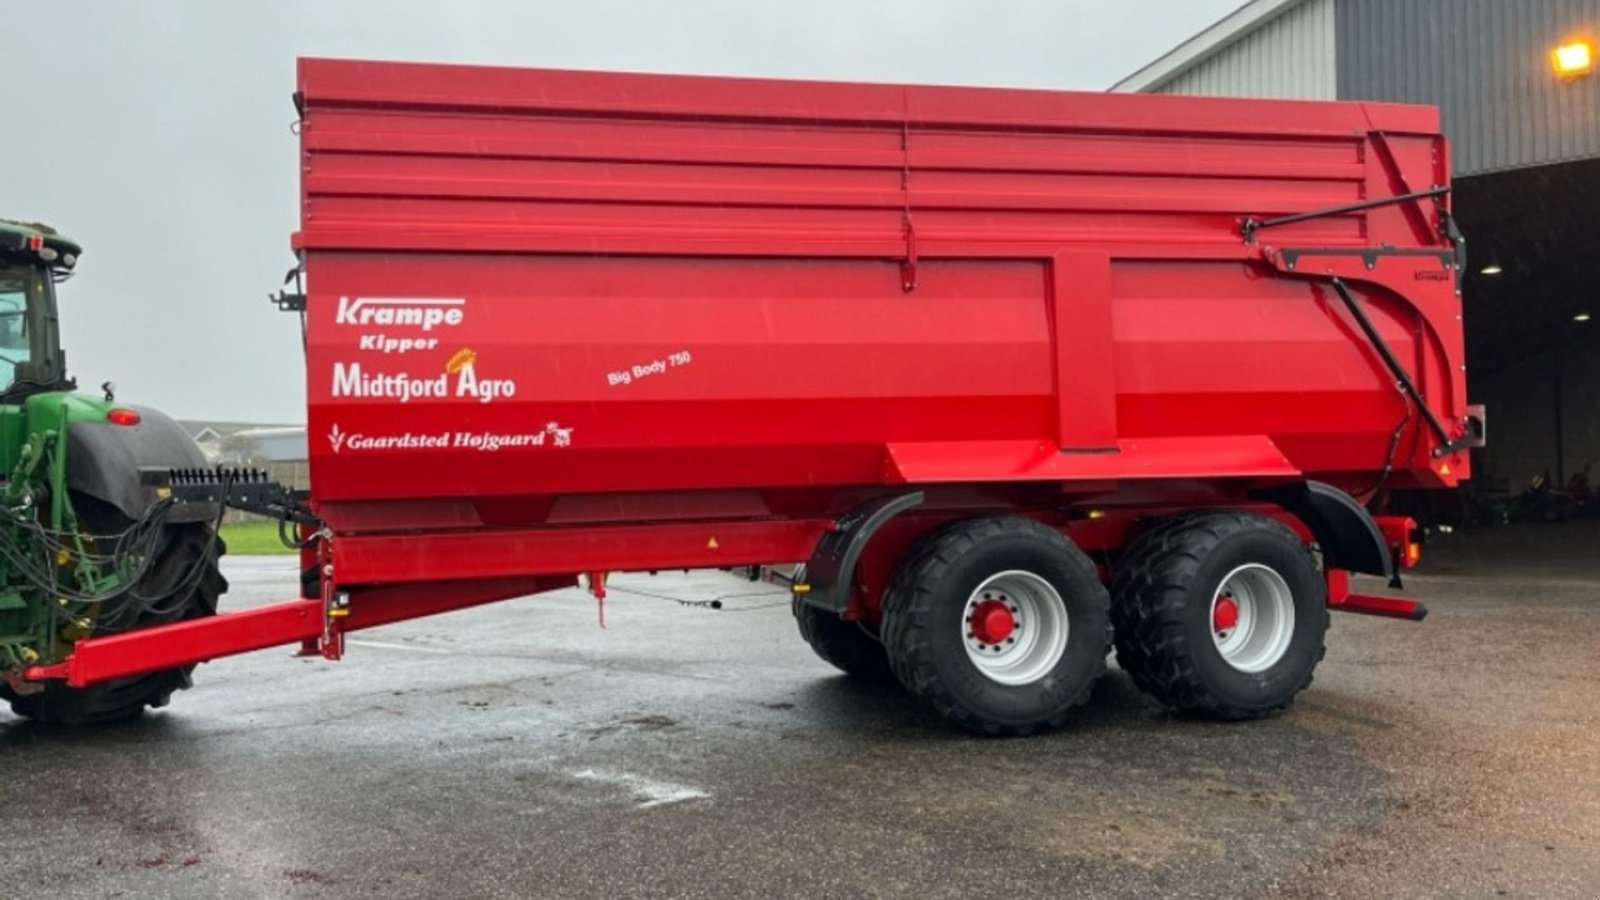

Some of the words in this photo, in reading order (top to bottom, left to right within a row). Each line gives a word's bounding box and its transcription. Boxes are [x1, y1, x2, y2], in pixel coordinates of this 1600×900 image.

[336, 297, 465, 330] Krampe
[360, 335, 438, 352] Kipper
[332, 362, 447, 402] Midtfjord
[457, 365, 515, 403] Agro
[607, 371, 631, 386] Big
[632, 360, 666, 378] Body
[668, 351, 691, 366] 750
[347, 433, 449, 450] Gaardsted
[454, 430, 546, 449] Højgaard
